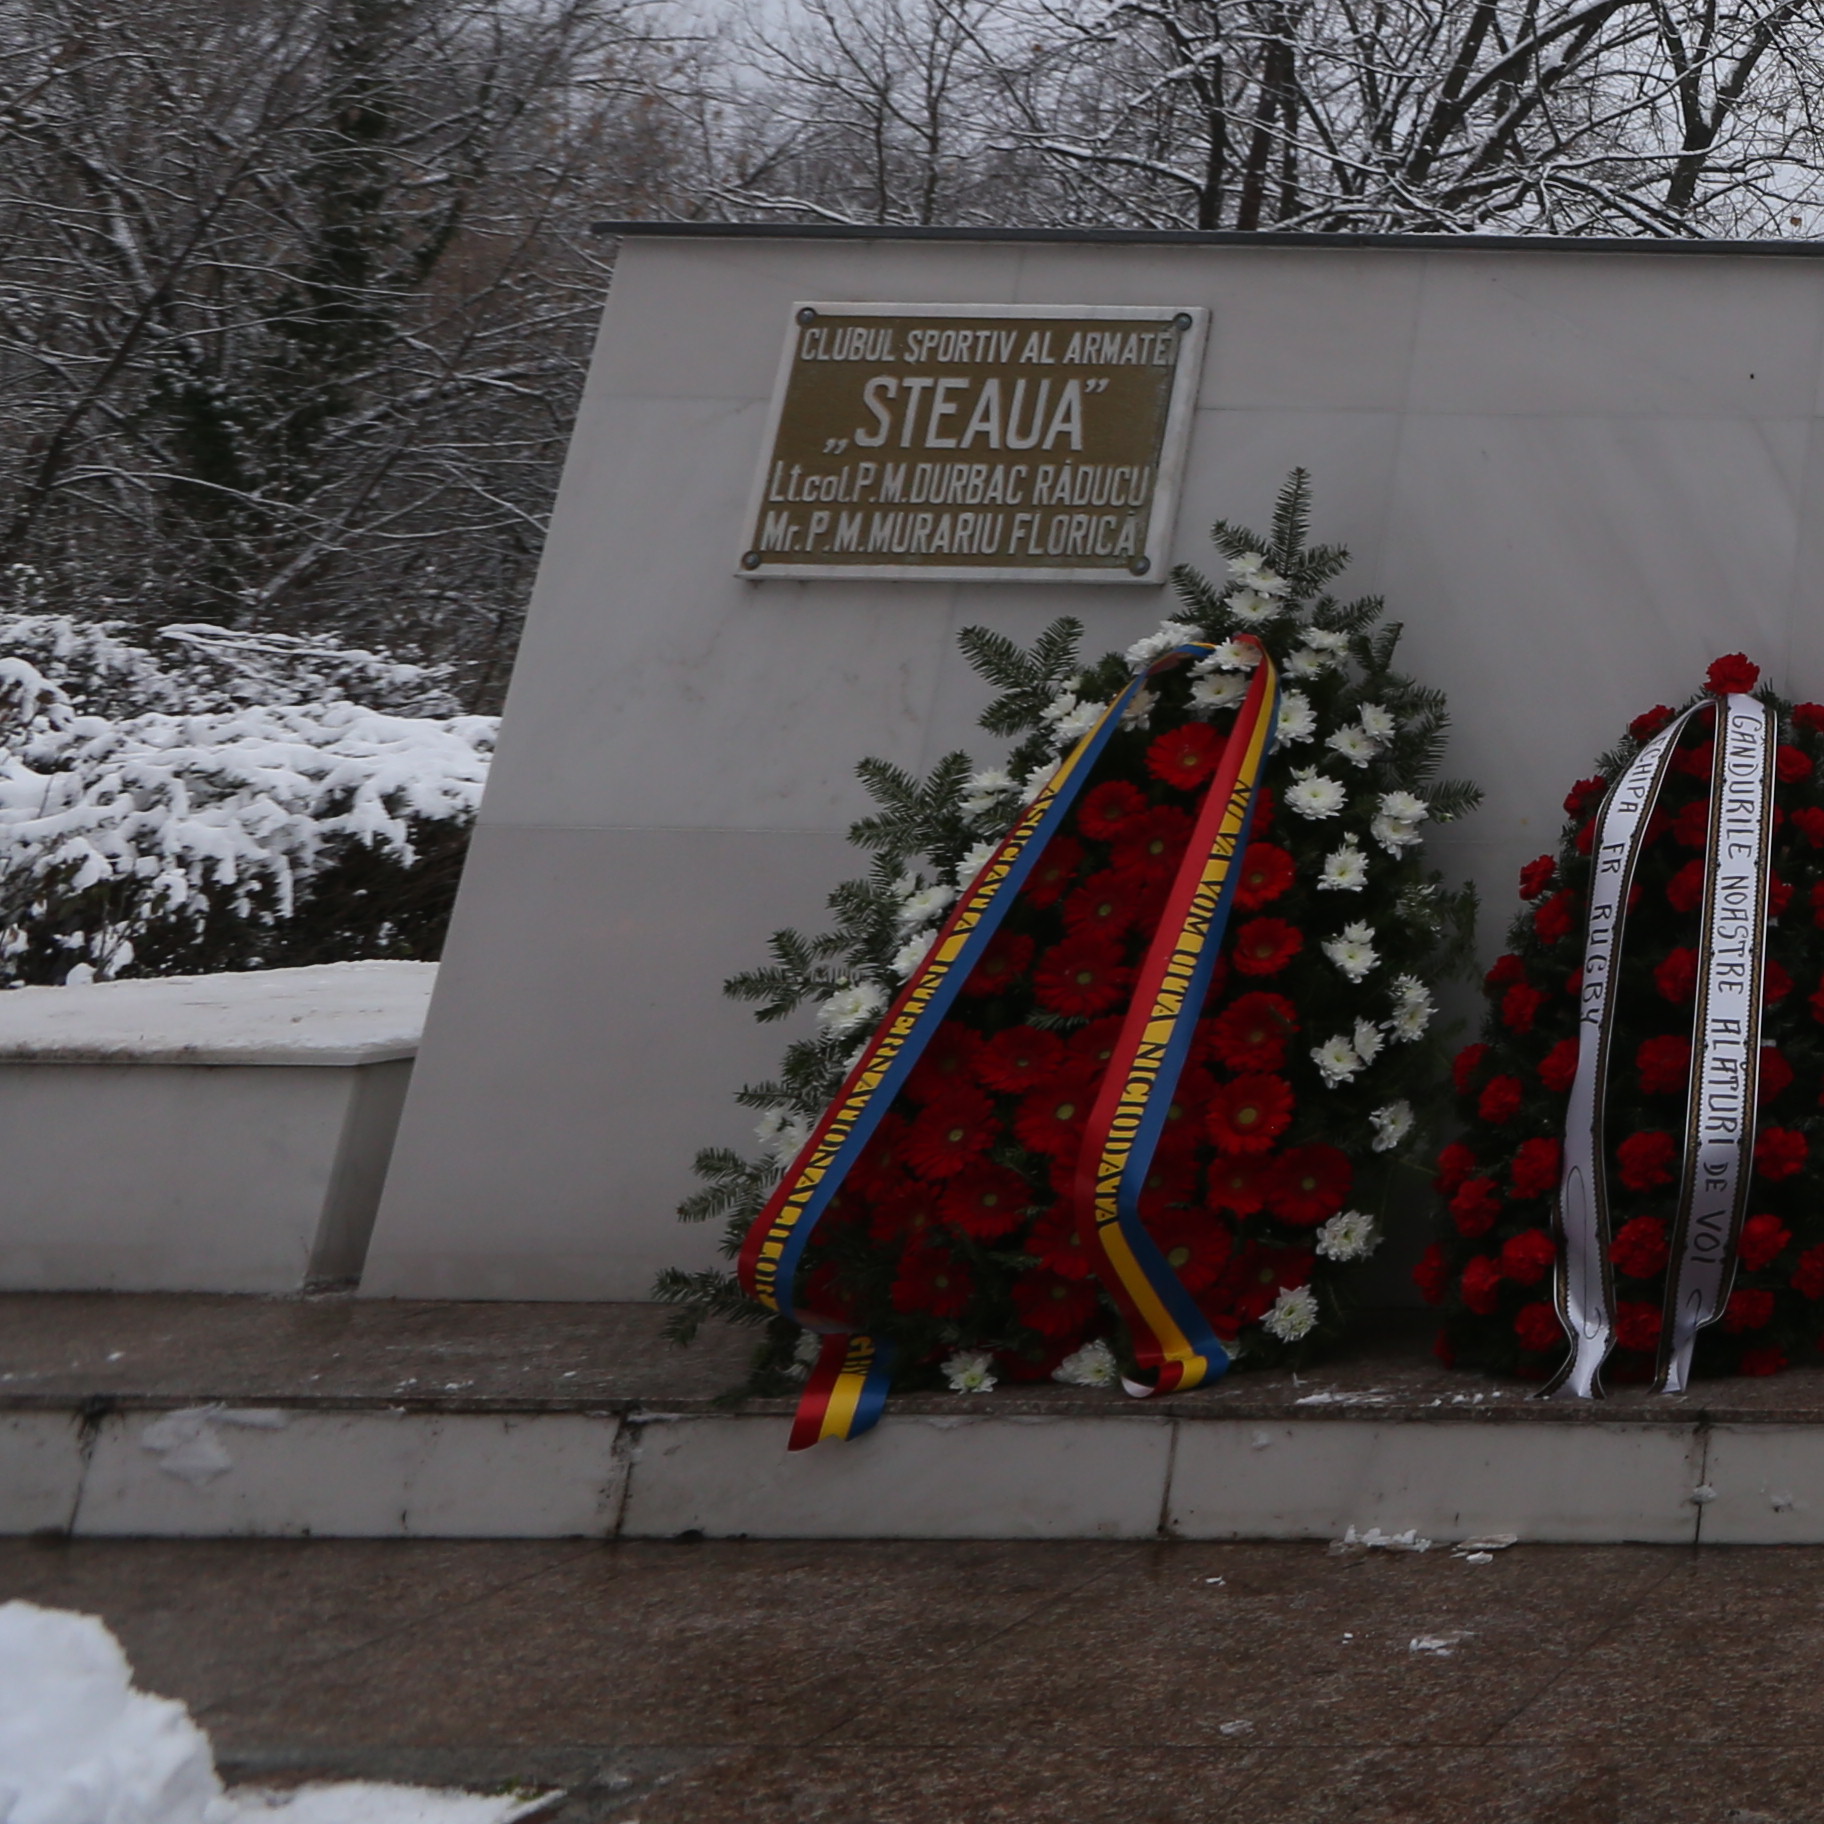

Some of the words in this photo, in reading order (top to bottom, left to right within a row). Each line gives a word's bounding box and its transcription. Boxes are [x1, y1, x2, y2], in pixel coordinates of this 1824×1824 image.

[801, 327, 896, 363] CLUBUL
[903, 328, 1019, 364] SPORTIV
[1019, 331, 1054, 365] AL
[1226, 779, 1251, 821] NU
[1617, 736, 1667, 814] ECHIPA
[1600, 841, 1626, 875] FR
[1182, 880, 1223, 937] VOM
[1716, 875, 1750, 995] NOASTRE
[1580, 904, 1612, 1026] RUGBY
[1703, 1161, 1728, 1193] DE
[1690, 1209, 1726, 1264] VOI
